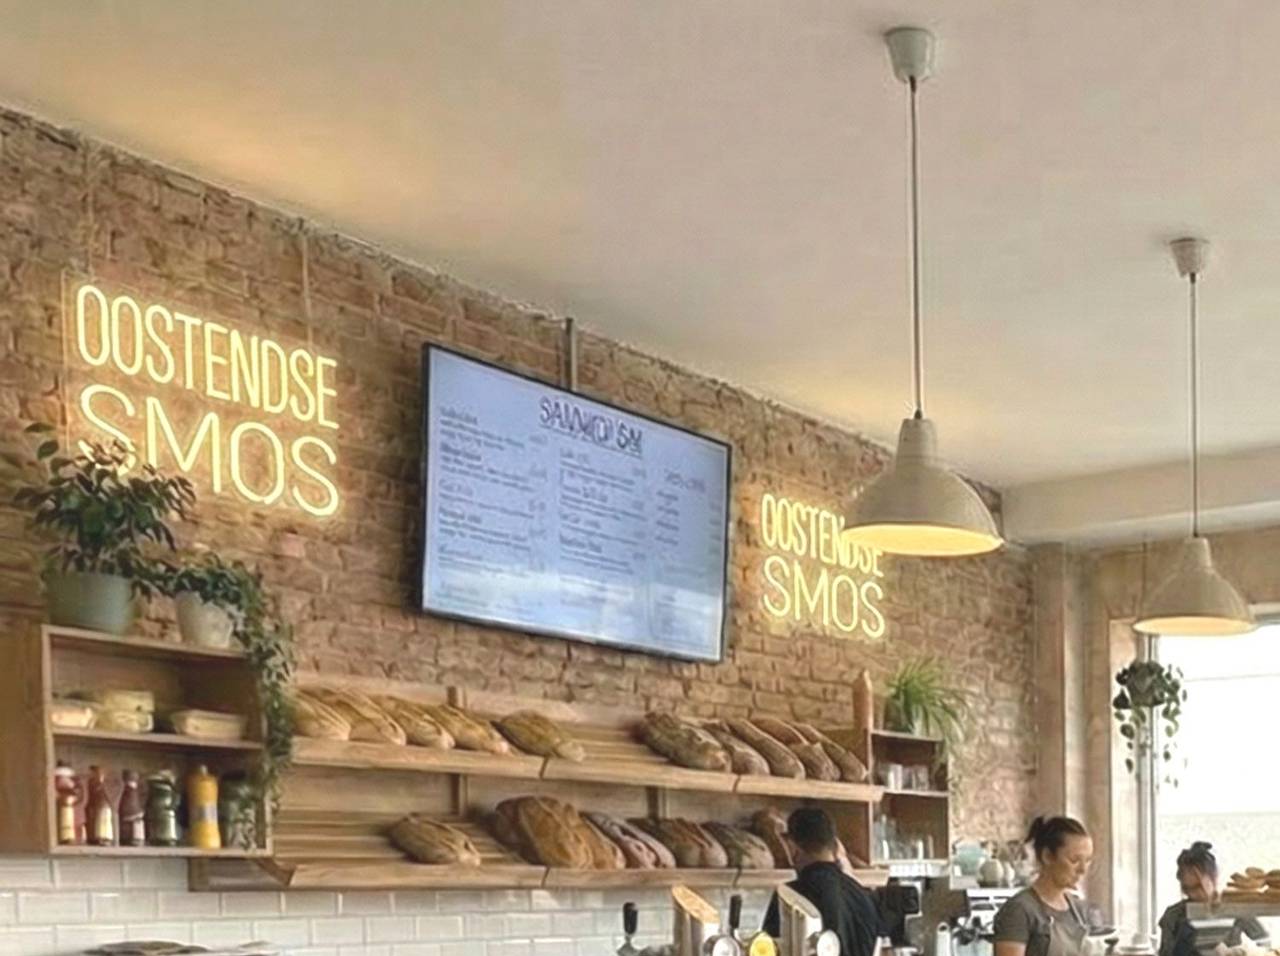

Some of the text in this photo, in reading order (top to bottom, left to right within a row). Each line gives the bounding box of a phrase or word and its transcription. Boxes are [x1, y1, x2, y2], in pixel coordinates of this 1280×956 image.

[76, 284, 340, 430] OOSTENDSE
[78, 383, 340, 517] SMOS
[763, 555, 886, 639] SMOS
